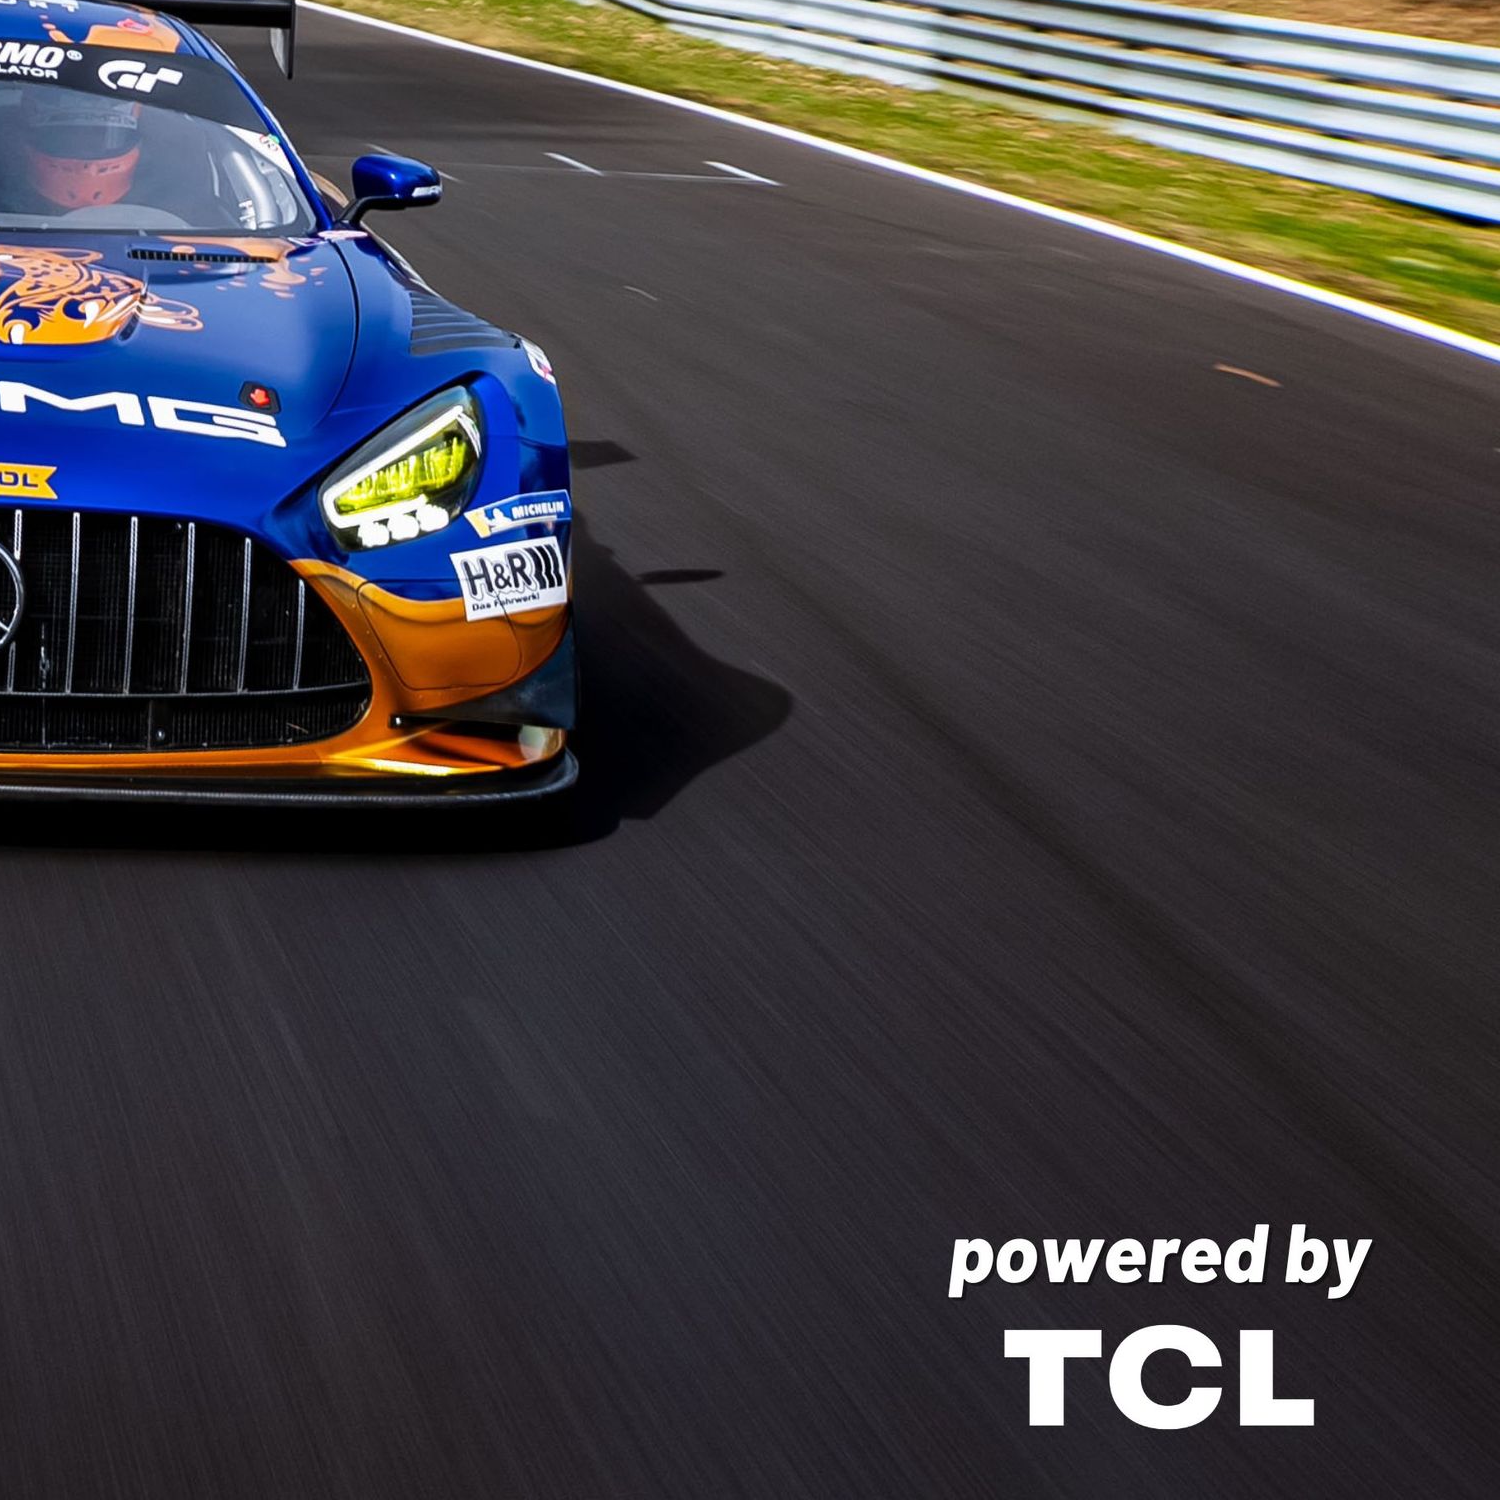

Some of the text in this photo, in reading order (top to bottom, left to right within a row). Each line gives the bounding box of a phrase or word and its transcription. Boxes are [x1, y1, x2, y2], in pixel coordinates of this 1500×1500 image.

[511, 501, 565, 520] MICHELIN
[463, 552, 532, 596] H&R
[472, 601, 492, 611] Das
